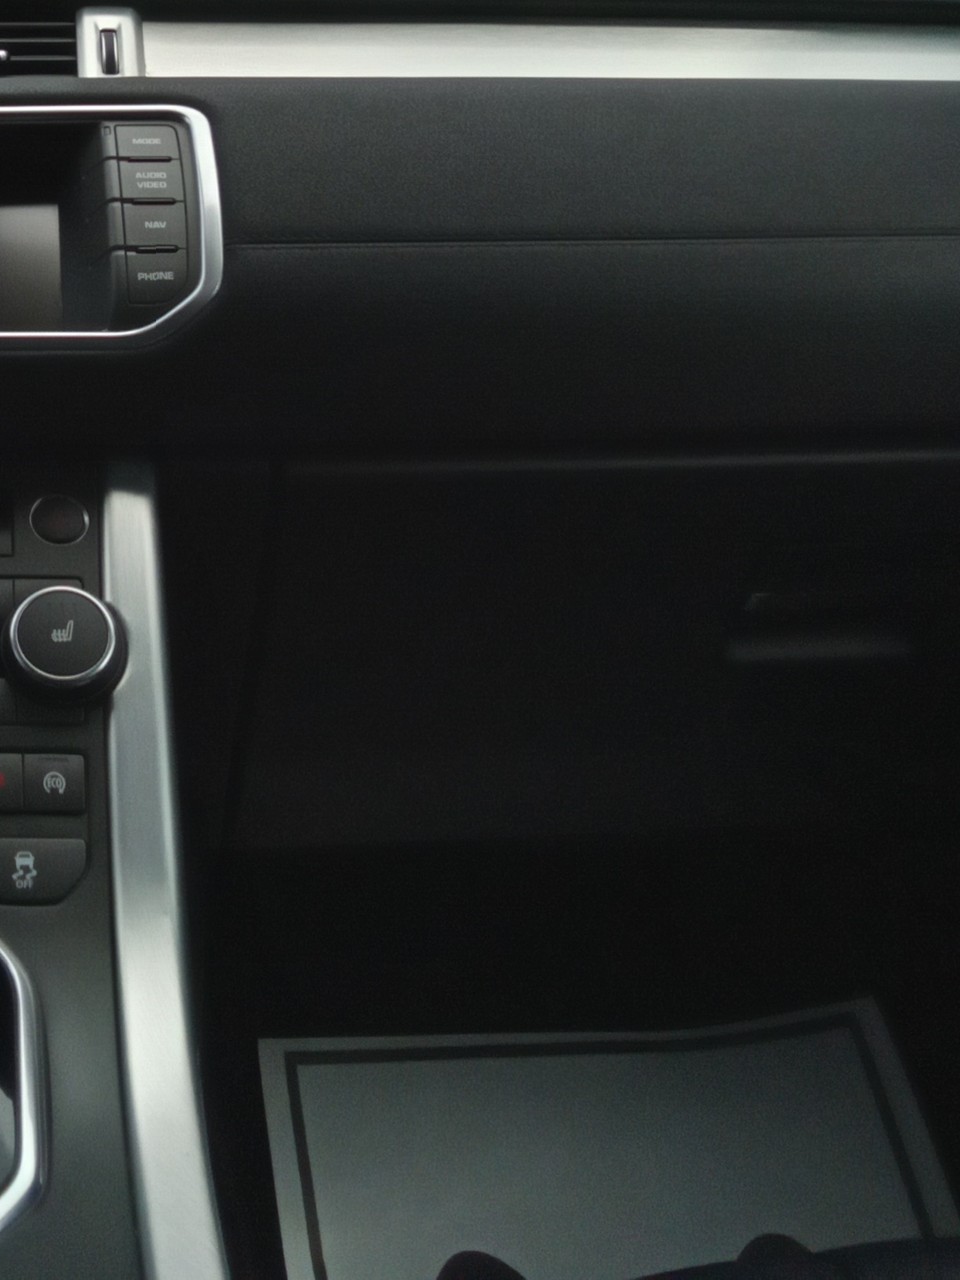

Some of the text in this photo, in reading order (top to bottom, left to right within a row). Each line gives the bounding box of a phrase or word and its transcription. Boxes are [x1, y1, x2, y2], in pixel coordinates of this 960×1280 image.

[136, 181, 167, 189] VIDEO
[144, 221, 167, 229] NAV
[137, 271, 174, 281] PHONE
[47, 776, 62, 788] ECO
[15, 879, 34, 890] OFF
